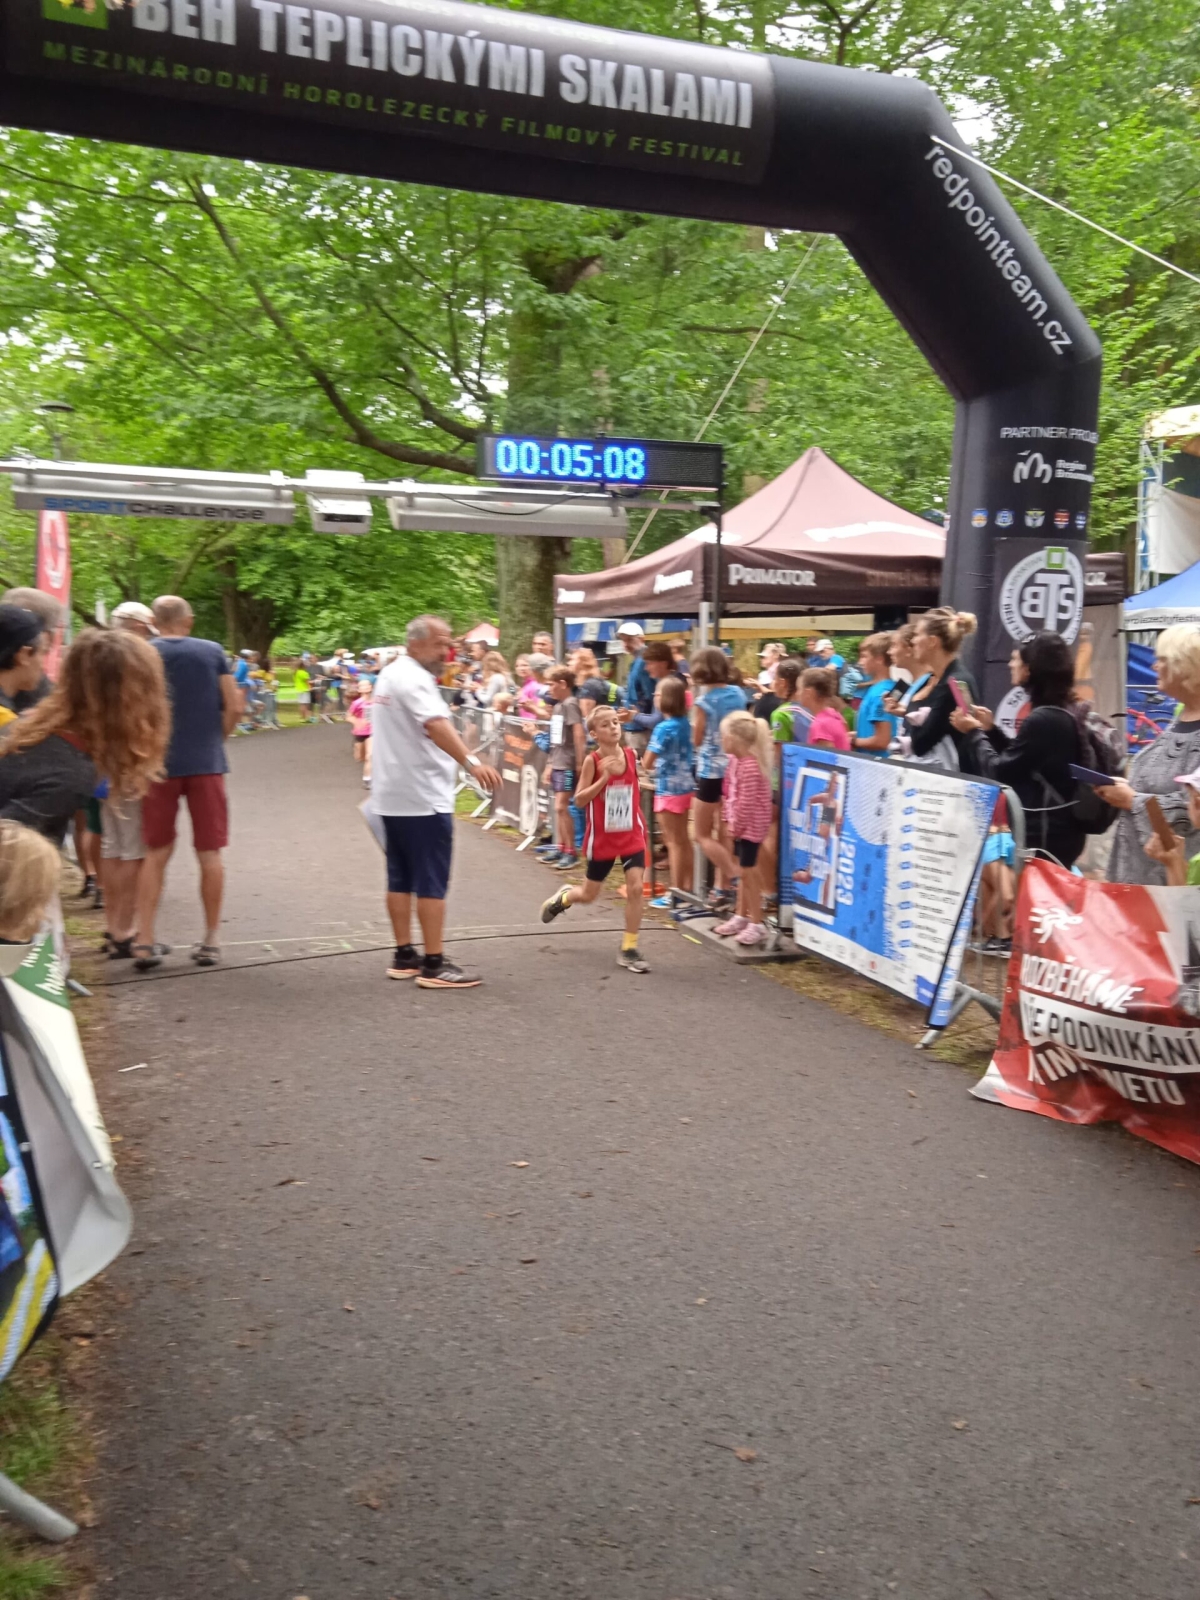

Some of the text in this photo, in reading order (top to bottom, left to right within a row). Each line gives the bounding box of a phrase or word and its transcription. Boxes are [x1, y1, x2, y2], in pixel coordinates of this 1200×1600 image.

[42, 41, 745, 167] MEZINÁRODNÍ HOROLEZECKÝ FILMOVÝ FESTIVAL
[252, 3, 546, 97] TEPLICKÝMI
[558, 54, 752, 129] SKALAMI
[924, 145, 1073, 355] redpointteam.cz
[496, 437, 646, 481] 00:05:08
[1000, 426, 1068, 439] PARTNER
[728, 563, 817, 587] PRIMATOR
